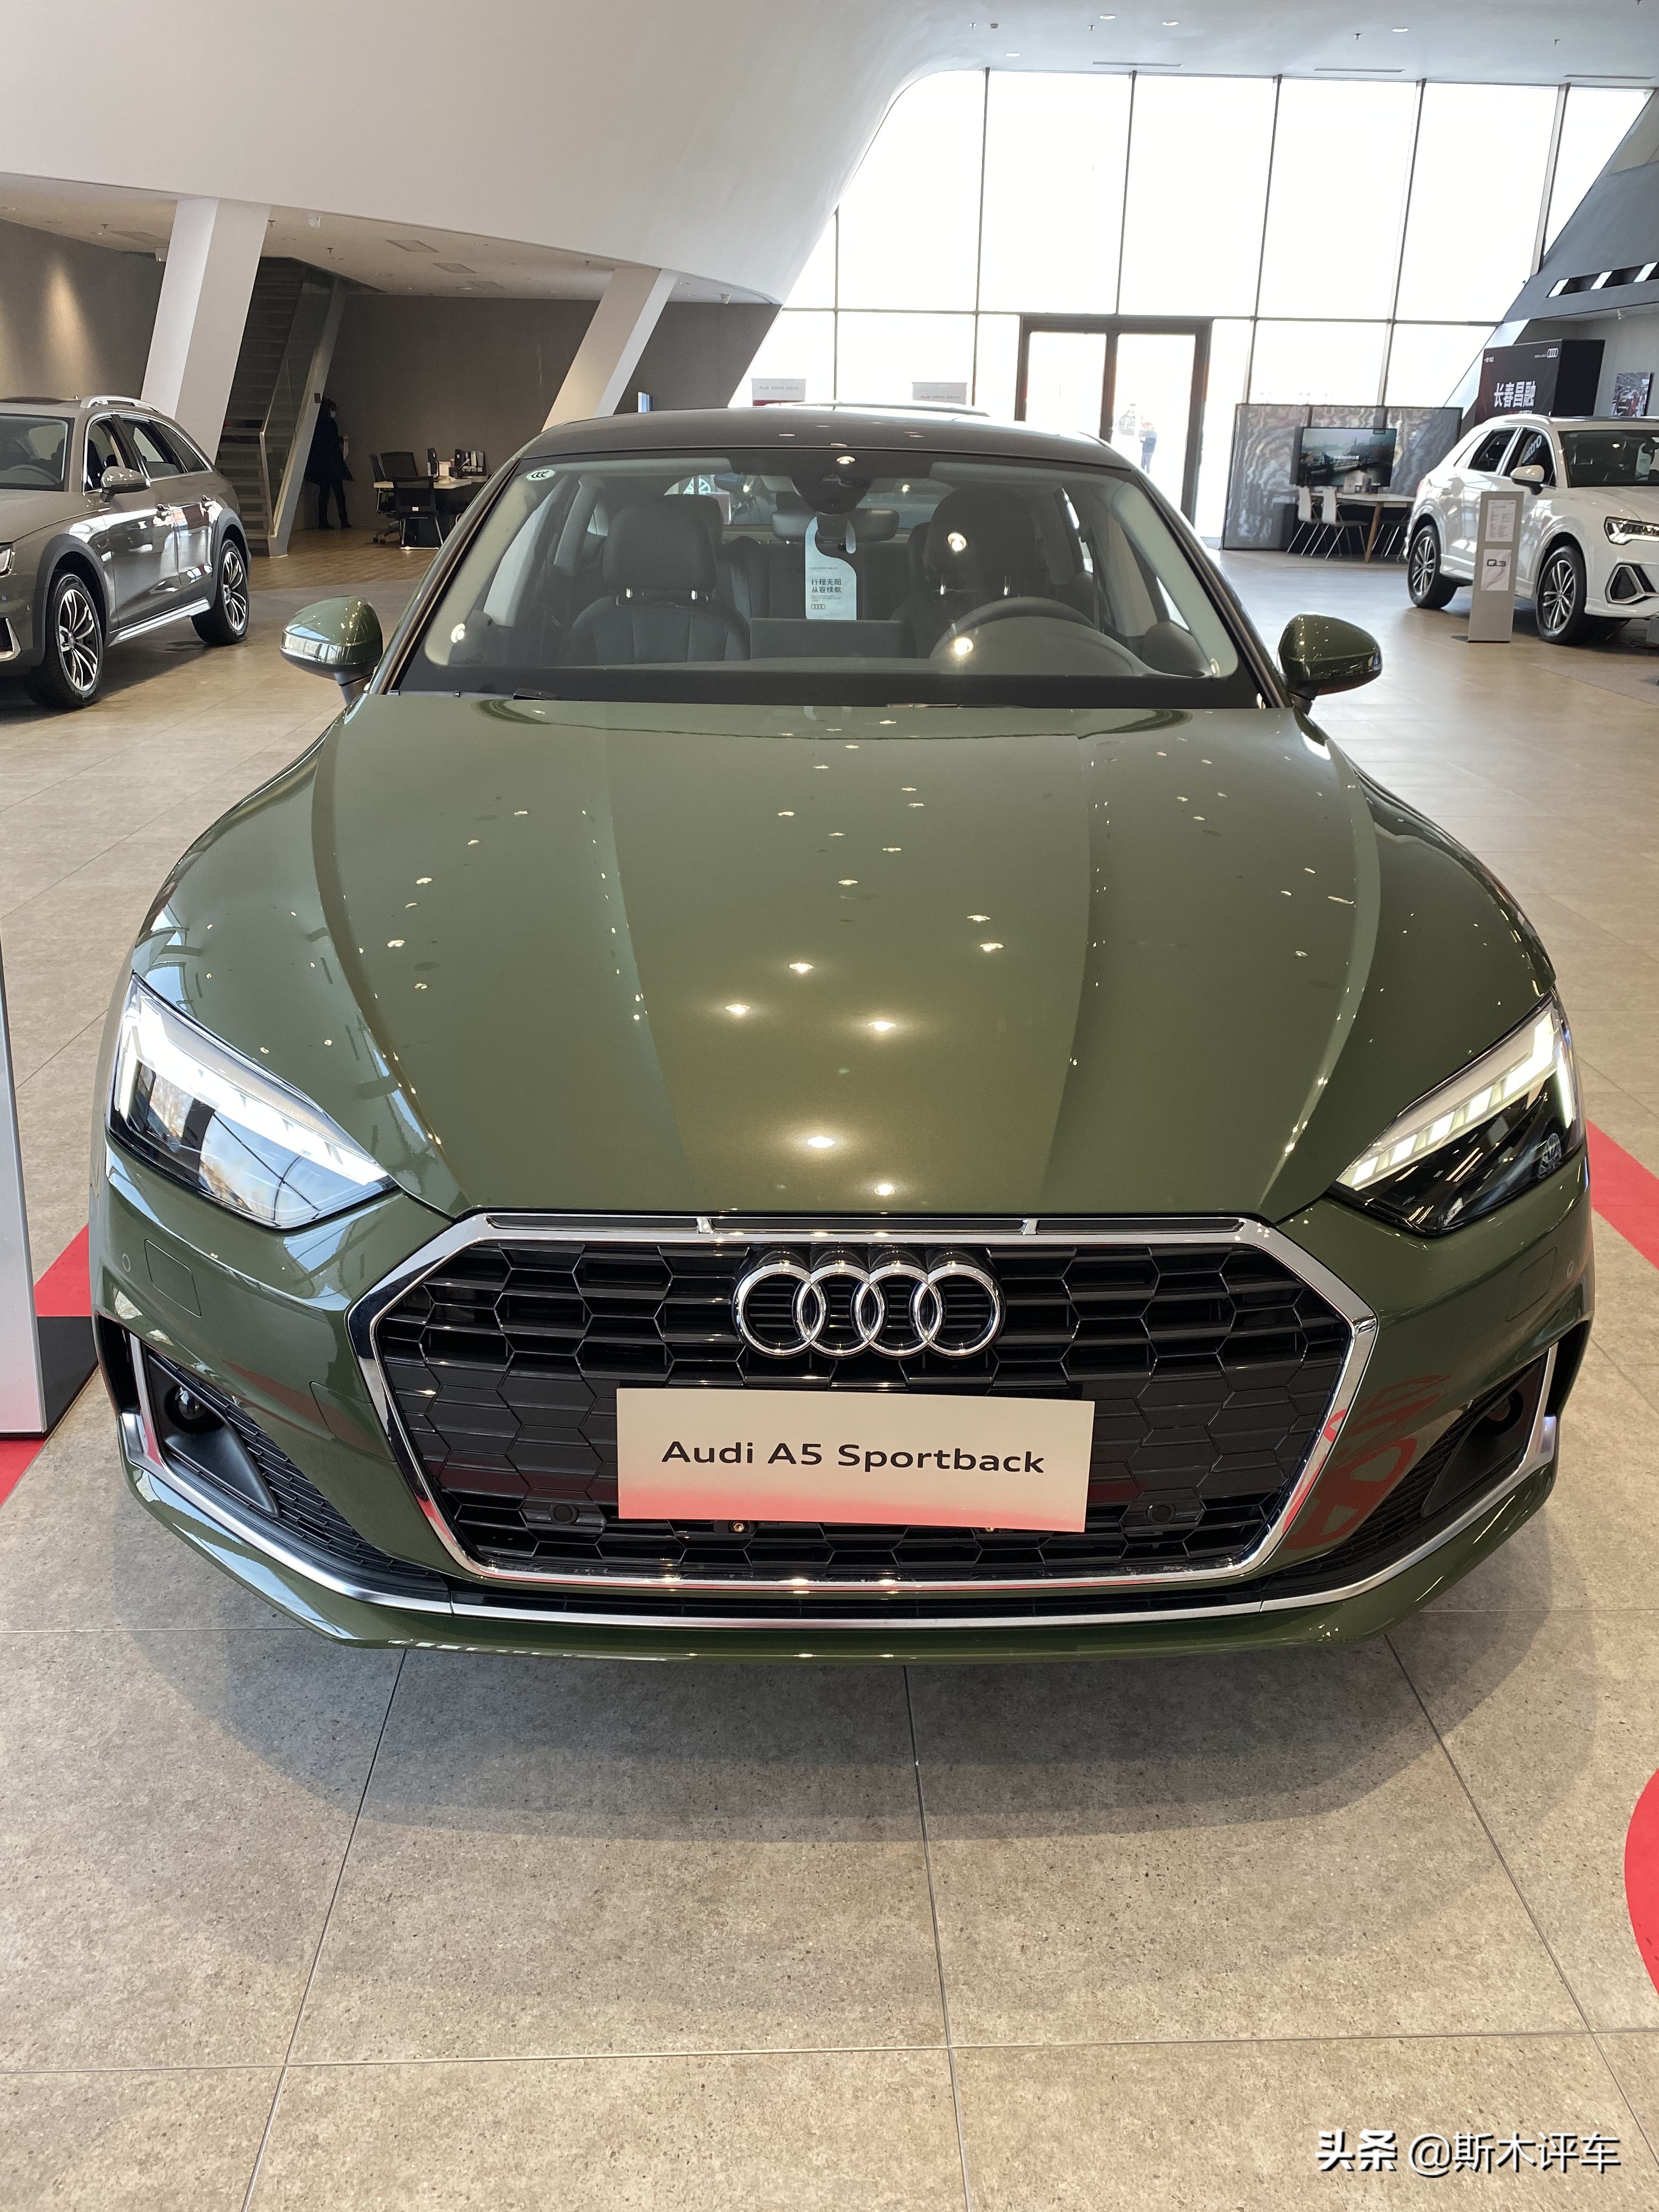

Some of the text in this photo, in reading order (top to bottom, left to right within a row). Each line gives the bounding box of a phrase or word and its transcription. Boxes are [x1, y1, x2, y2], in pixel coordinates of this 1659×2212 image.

[1494, 381, 1536, 408] 长春昌融
[662, 1441, 1045, 1473] Audi A5 Sportback
